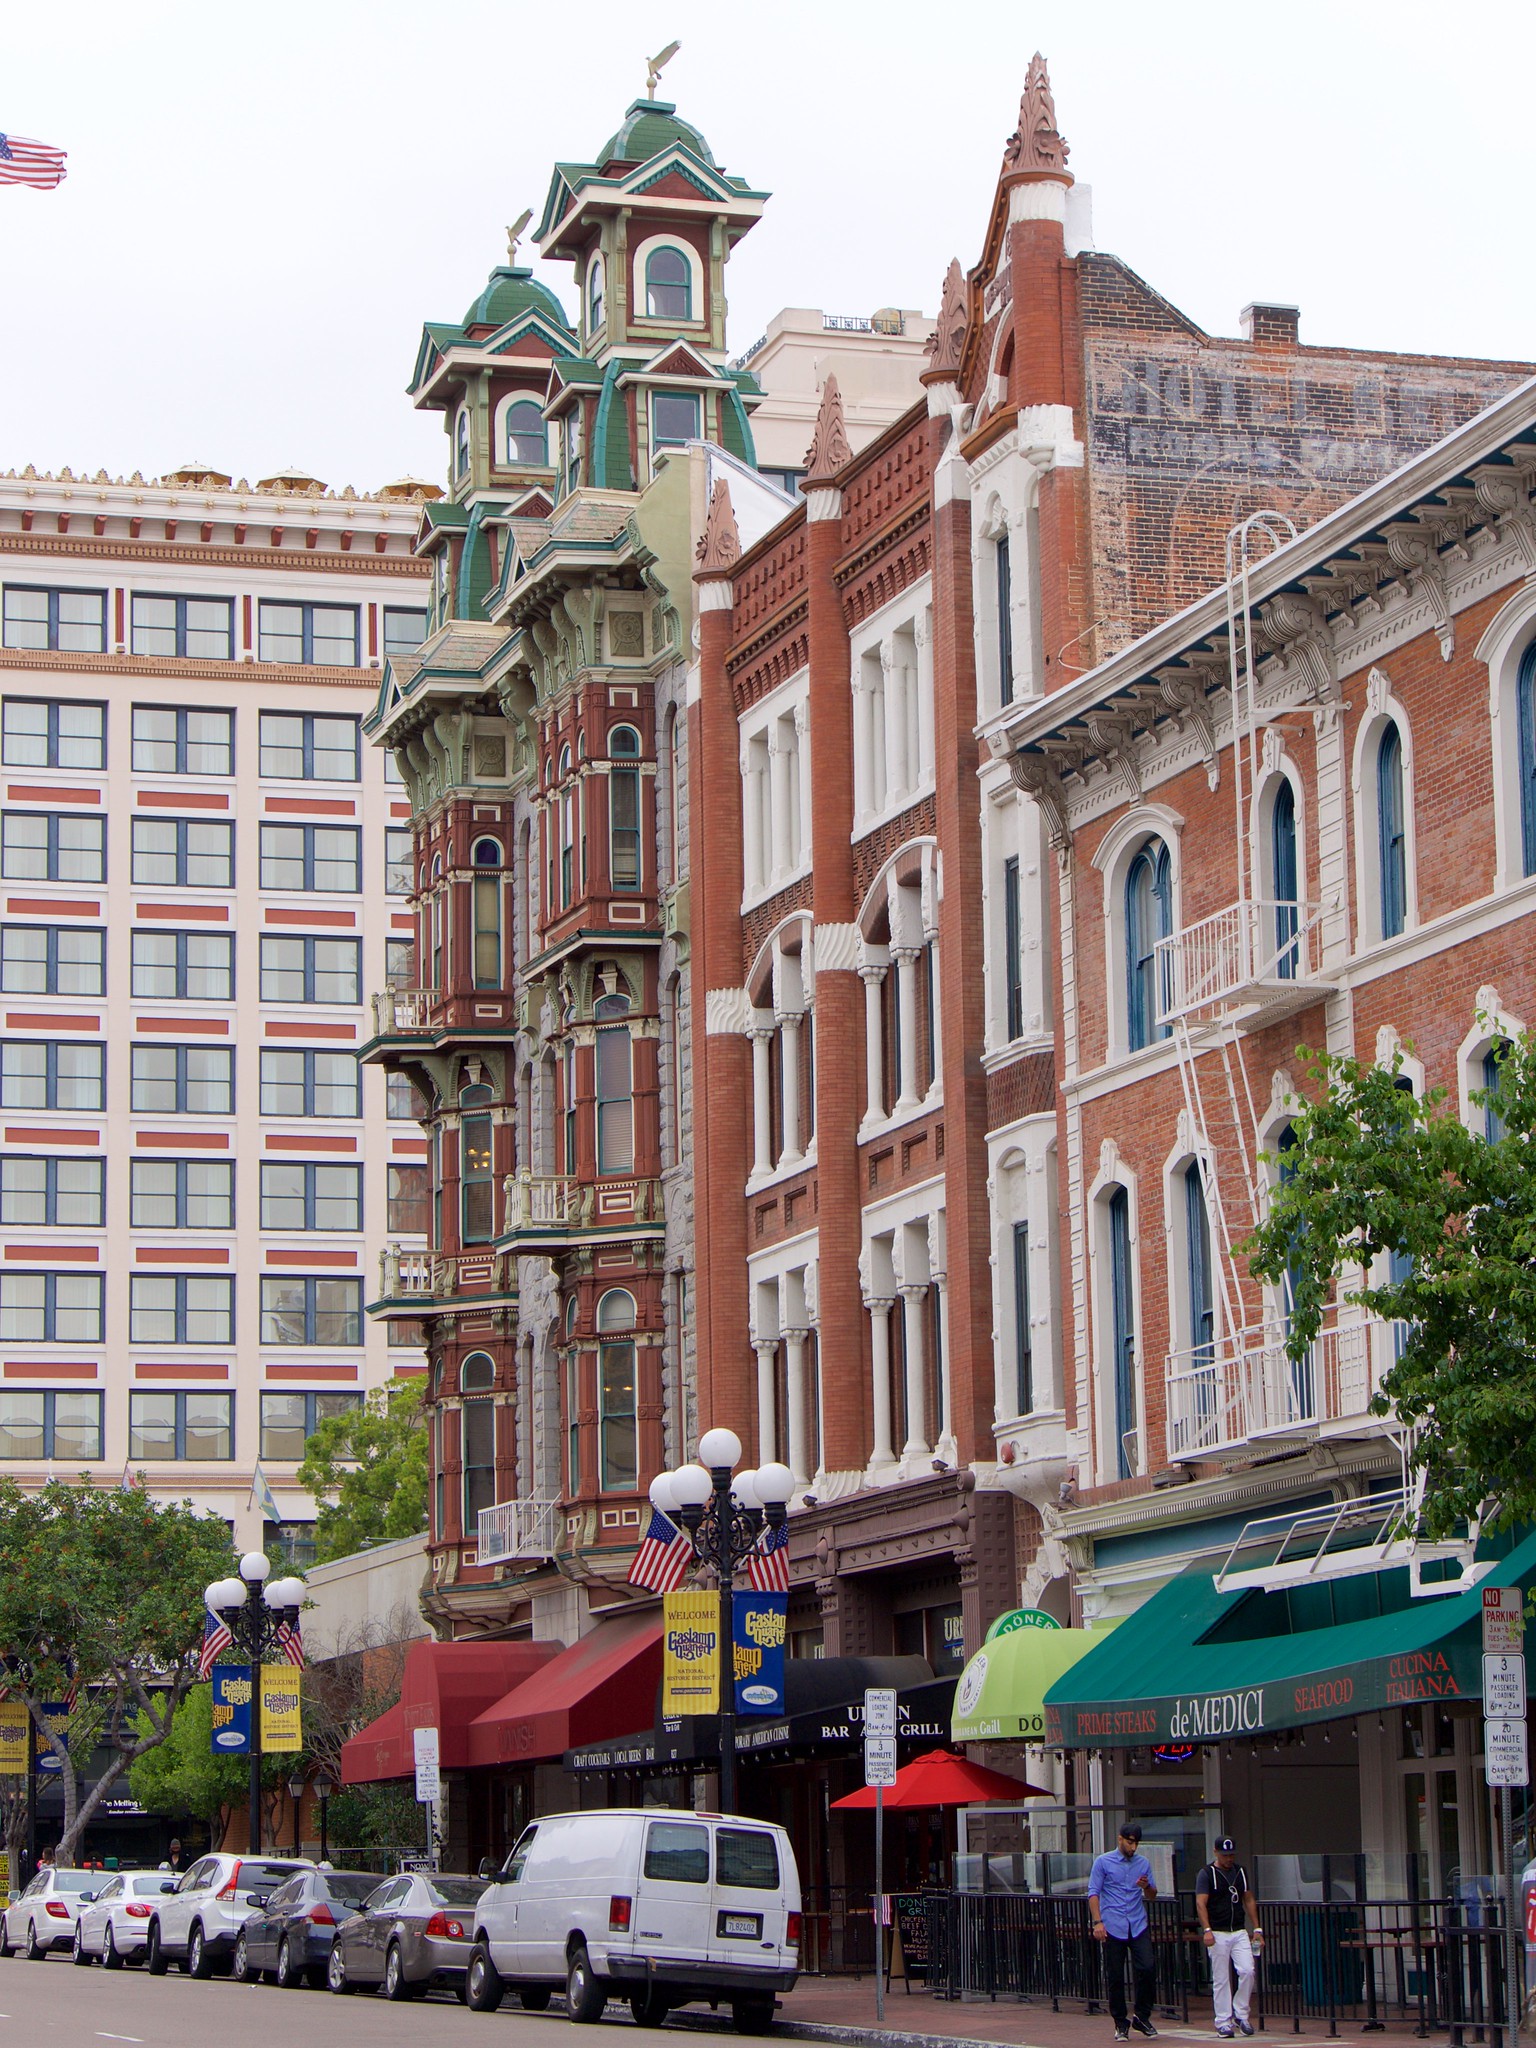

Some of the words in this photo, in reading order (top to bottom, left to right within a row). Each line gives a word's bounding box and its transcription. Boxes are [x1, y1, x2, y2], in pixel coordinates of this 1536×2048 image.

[1485, 1590, 1498, 1605] NO
[668, 1610, 717, 1620] WELCOME
[1486, 1610, 1519, 1623] PARKING
[668, 1628, 716, 1651] Gaslamp
[1390, 1652, 1450, 1679] CUCINA
[1501, 1658, 1508, 1671] 3
[1493, 1674, 1516, 1682] MINUTE
[1294, 1677, 1354, 1713] SEAFOOD
[1386, 1675, 1463, 1703] ITALIANA
[1170, 1689, 1264, 1739] de'MEDICI
[1077, 1711, 1113, 1736] PRIME
[1114, 1709, 1158, 1735] STEAKS
[821, 1725, 851, 1738] BAR
[900, 1723, 944, 1737] GRILL
[752, 1729, 773, 1748] AMERICAN
[1492, 1735, 1521, 1744] MINUTE
[878, 1743, 884, 1752] 3
[574, 1754, 587, 1767] CRAFT
[588, 1752, 610, 1765] COCKTAILS
[614, 1751, 628, 1764] LOCAL
[629, 1749, 641, 1763] BEERS
[646, 1747, 655, 1760] BAR
[898, 1897, 928, 1908] DÖNE
